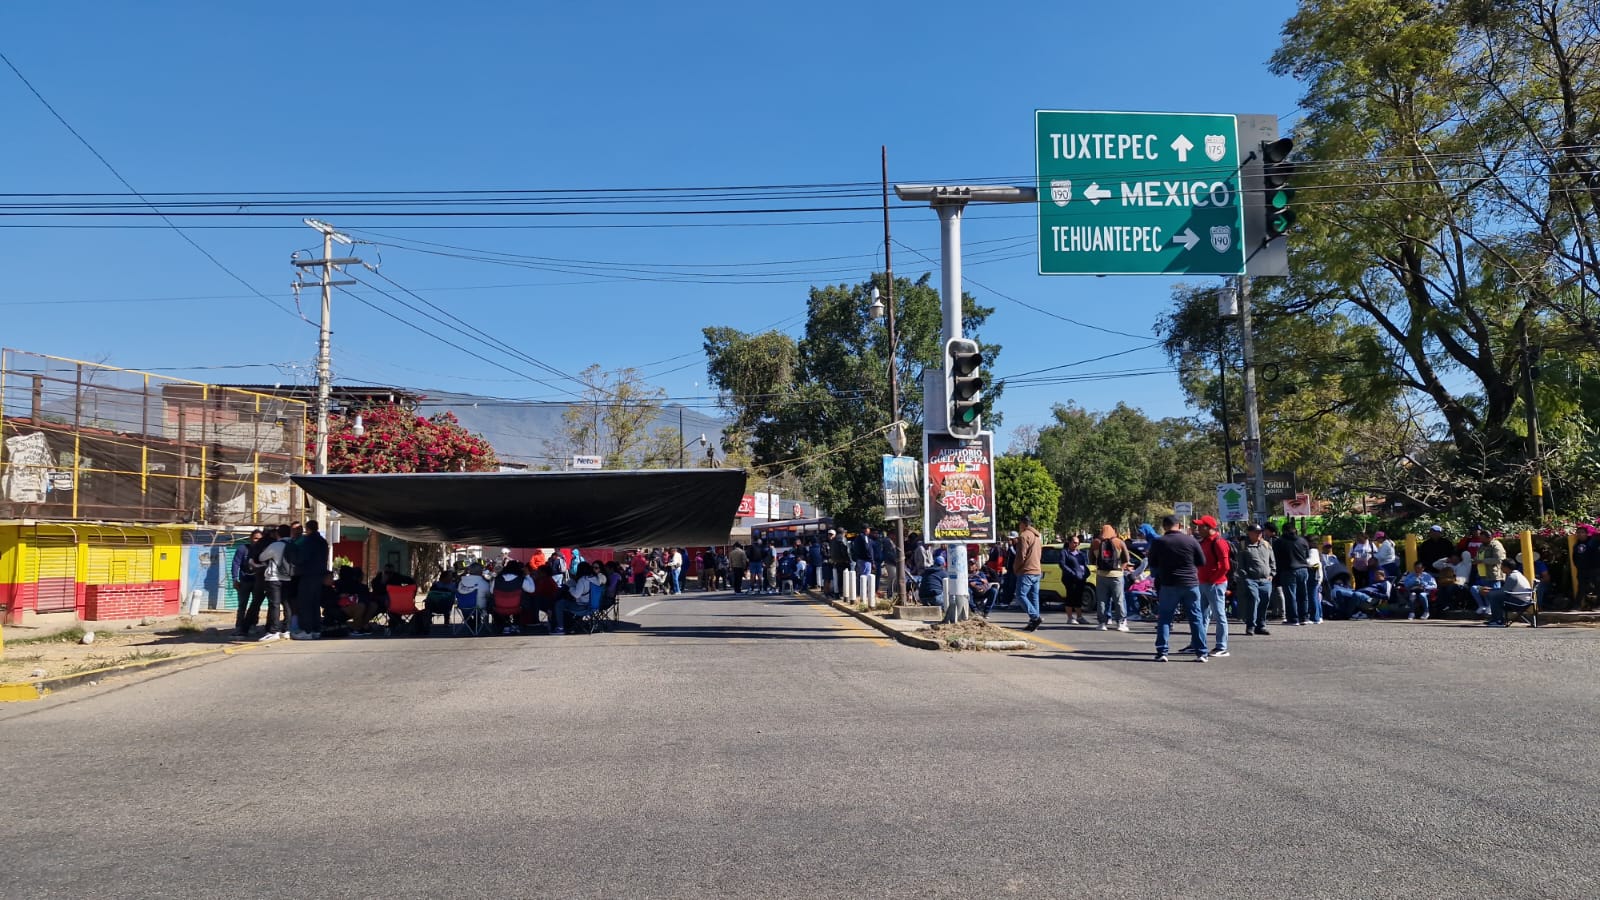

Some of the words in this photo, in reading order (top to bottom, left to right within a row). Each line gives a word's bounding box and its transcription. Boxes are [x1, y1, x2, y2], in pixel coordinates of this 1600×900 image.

[1050, 133, 1159, 160] TUXTEPEC
[1208, 145, 1222, 155] 175
[1053, 190, 1069, 200] 190
[1120, 181, 1230, 207] MEXICO
[1051, 226, 1162, 253] TEHUANTEPEC
[1213, 236, 1229, 246] 190
[938, 448, 983, 457] AUDITORIO
[1266, 481, 1291, 489] GRILL
[955, 490, 965, 498] EL
